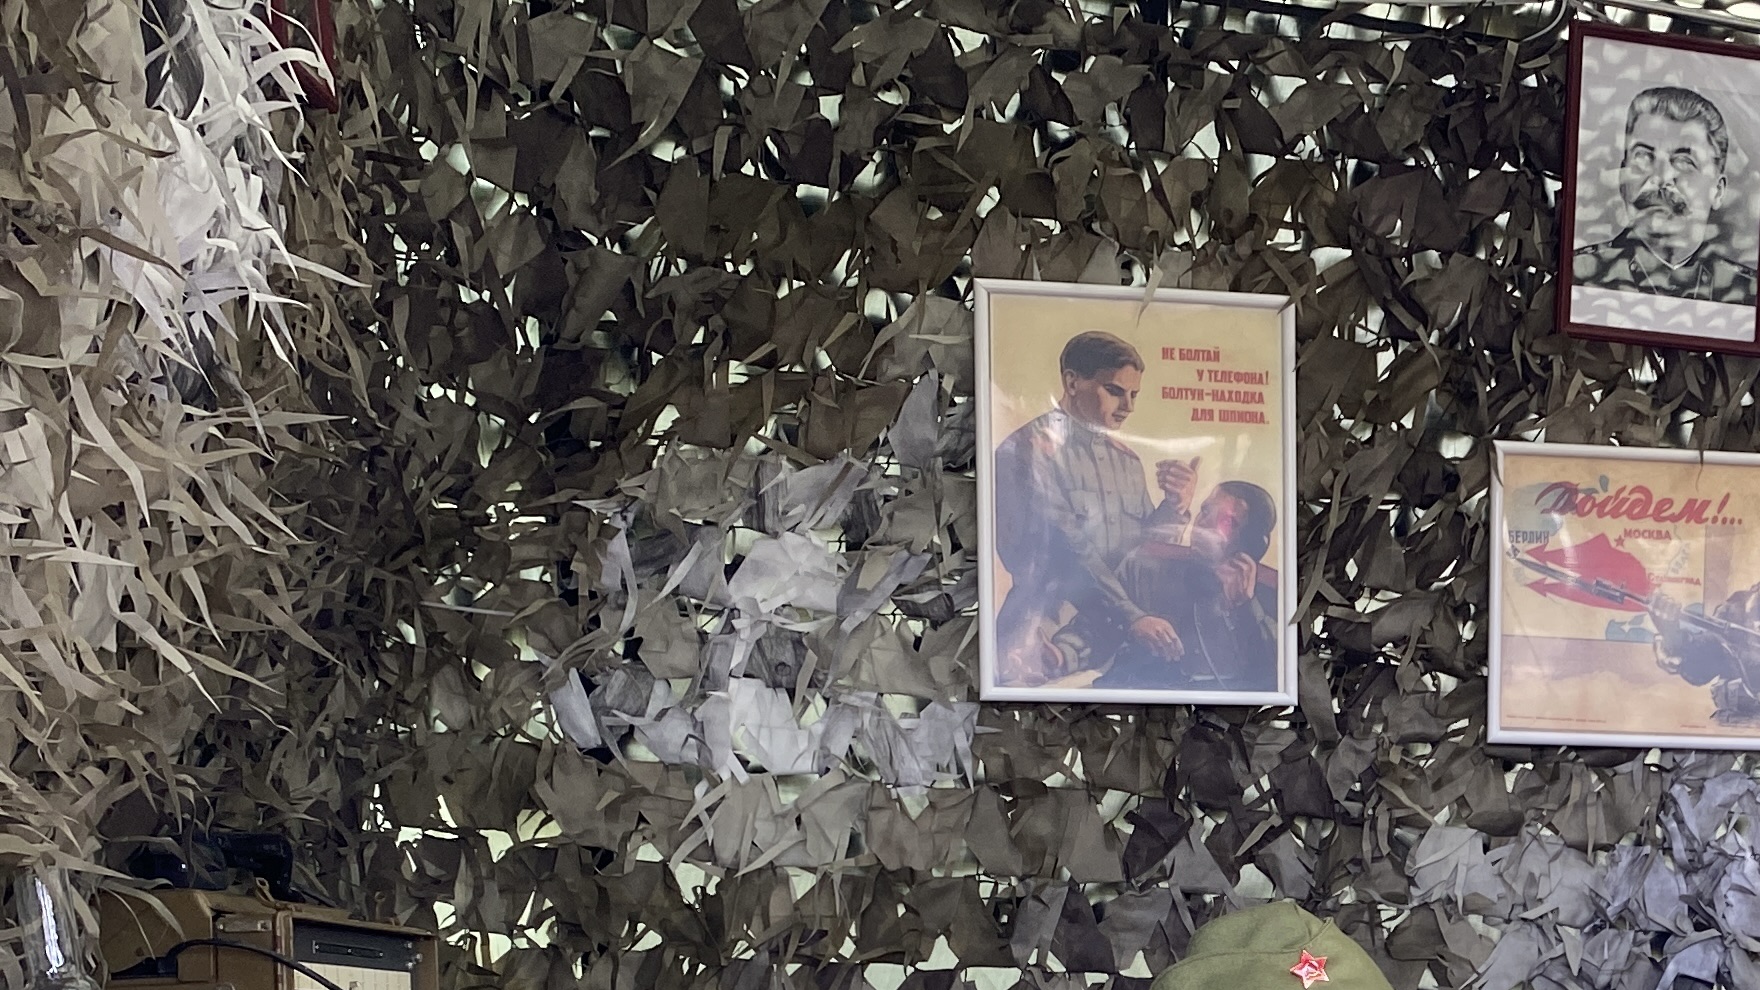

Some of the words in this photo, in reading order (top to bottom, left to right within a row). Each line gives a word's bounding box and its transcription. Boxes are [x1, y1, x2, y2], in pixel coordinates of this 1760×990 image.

[1162, 347, 1175, 360] НЕ
[1179, 346, 1220, 363] БОЛТАЙ
[1196, 369, 1204, 382] У
[1207, 369, 1269, 385] ТЕЛЕФОНА!
[1161, 386, 1265, 405] БОЛТУН-НАХОДКА
[1191, 408, 1214, 422] ДЛЯ
[1219, 409, 1270, 425] ШПИОНА.
[1534, 481, 1743, 525] Дойдем!...
[1508, 530, 1550, 544] БЕРЛИН
[1623, 528, 1672, 541] МОСКВА
